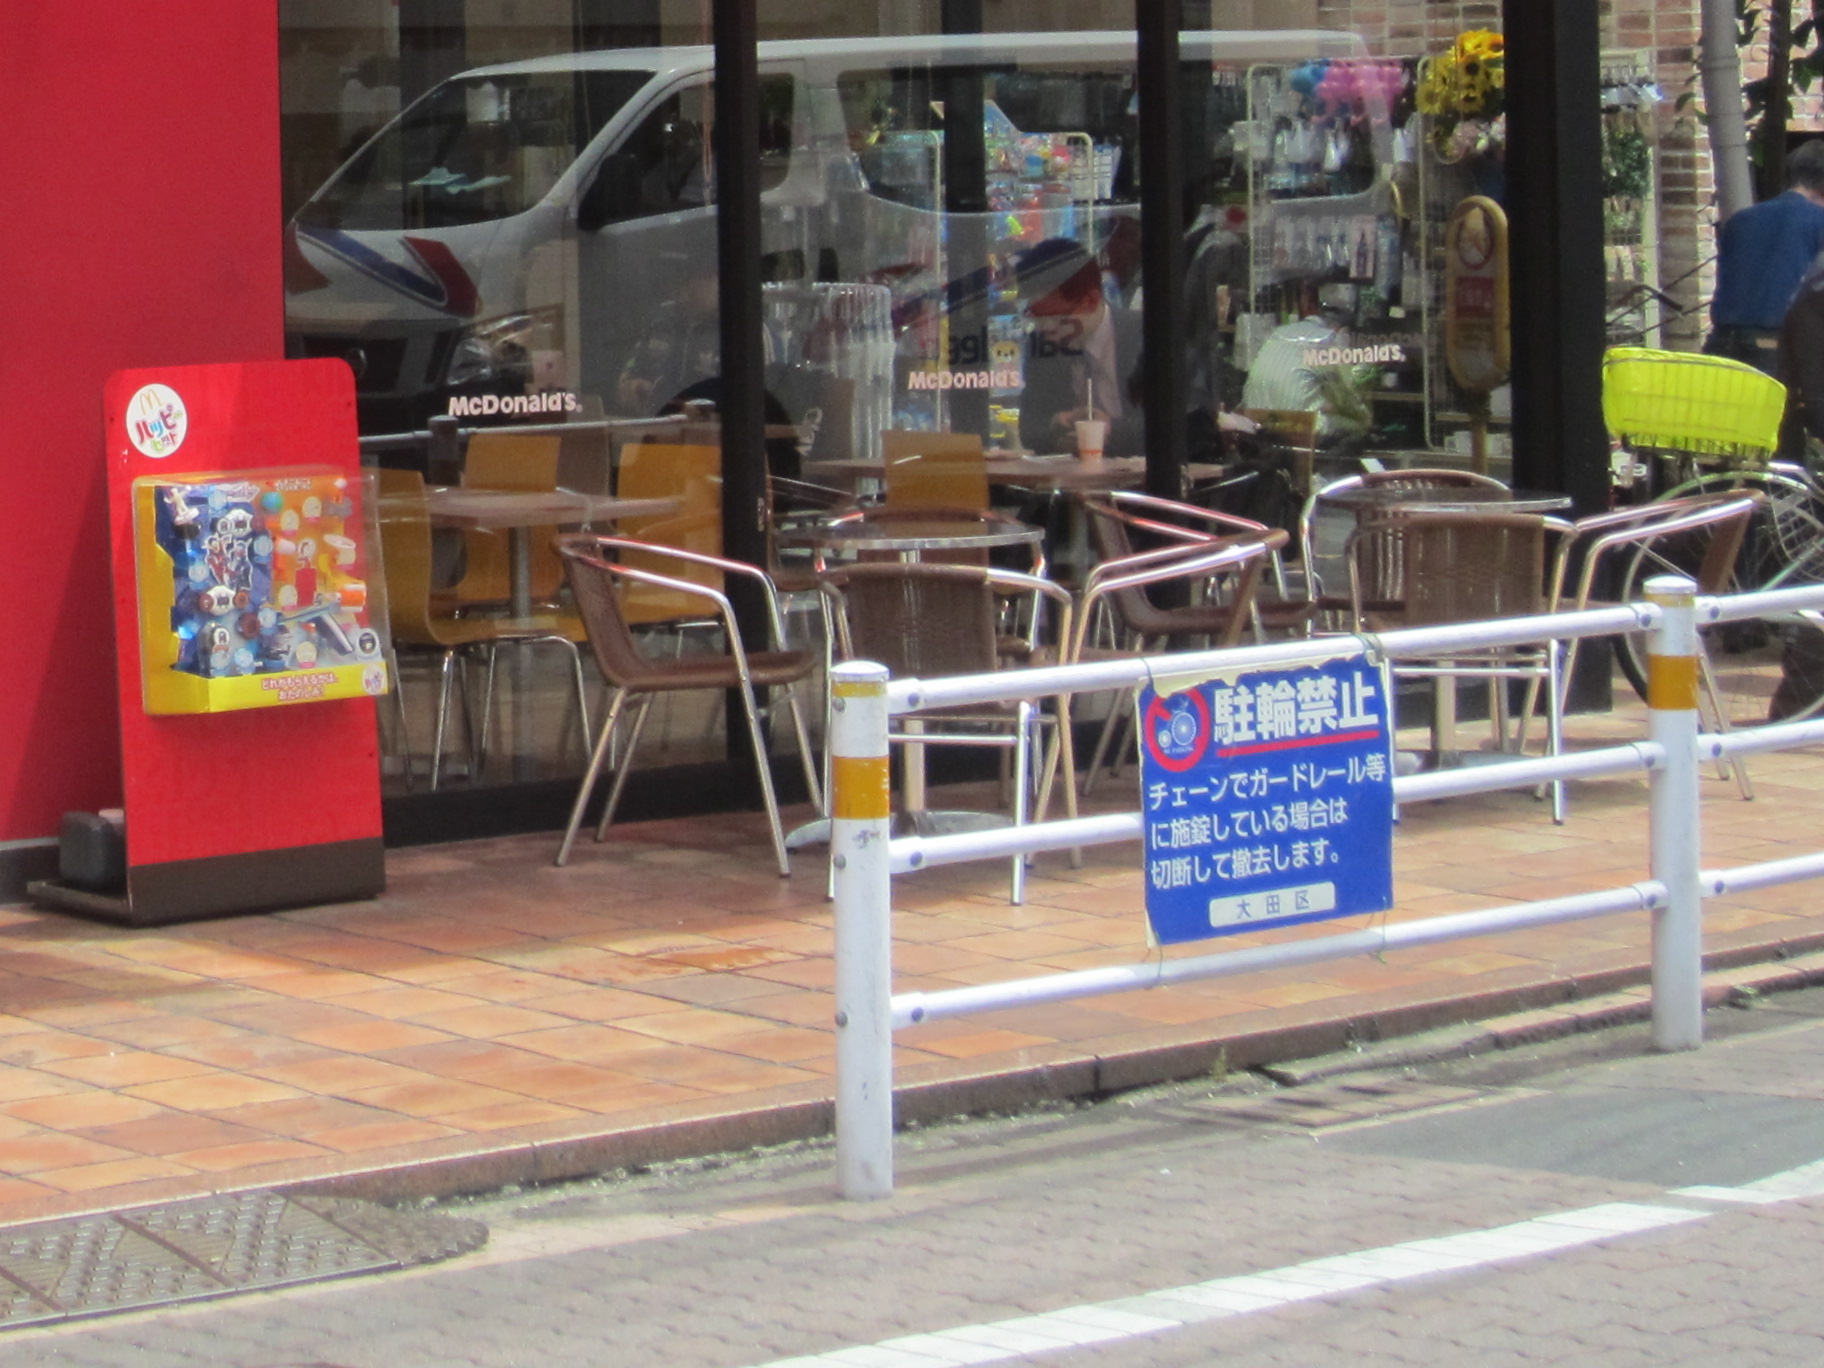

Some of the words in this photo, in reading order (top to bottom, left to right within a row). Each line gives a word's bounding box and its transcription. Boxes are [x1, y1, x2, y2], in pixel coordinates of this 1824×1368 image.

[1302, 344, 1402, 366] McDonald's
[907, 370, 1020, 390] McDonald's
[136, 403, 183, 444] ハッピー
[448, 392, 577, 417] McDonald's
[1214, 672, 1379, 744] 駐輪禁止
[1149, 754, 1386, 810] チェーンでガードレール等
[1151, 797, 1348, 850] に施錠している場合は
[1151, 838, 1339, 889] 切断して撤去します。
[1237, 890, 1310, 919] 大田区
